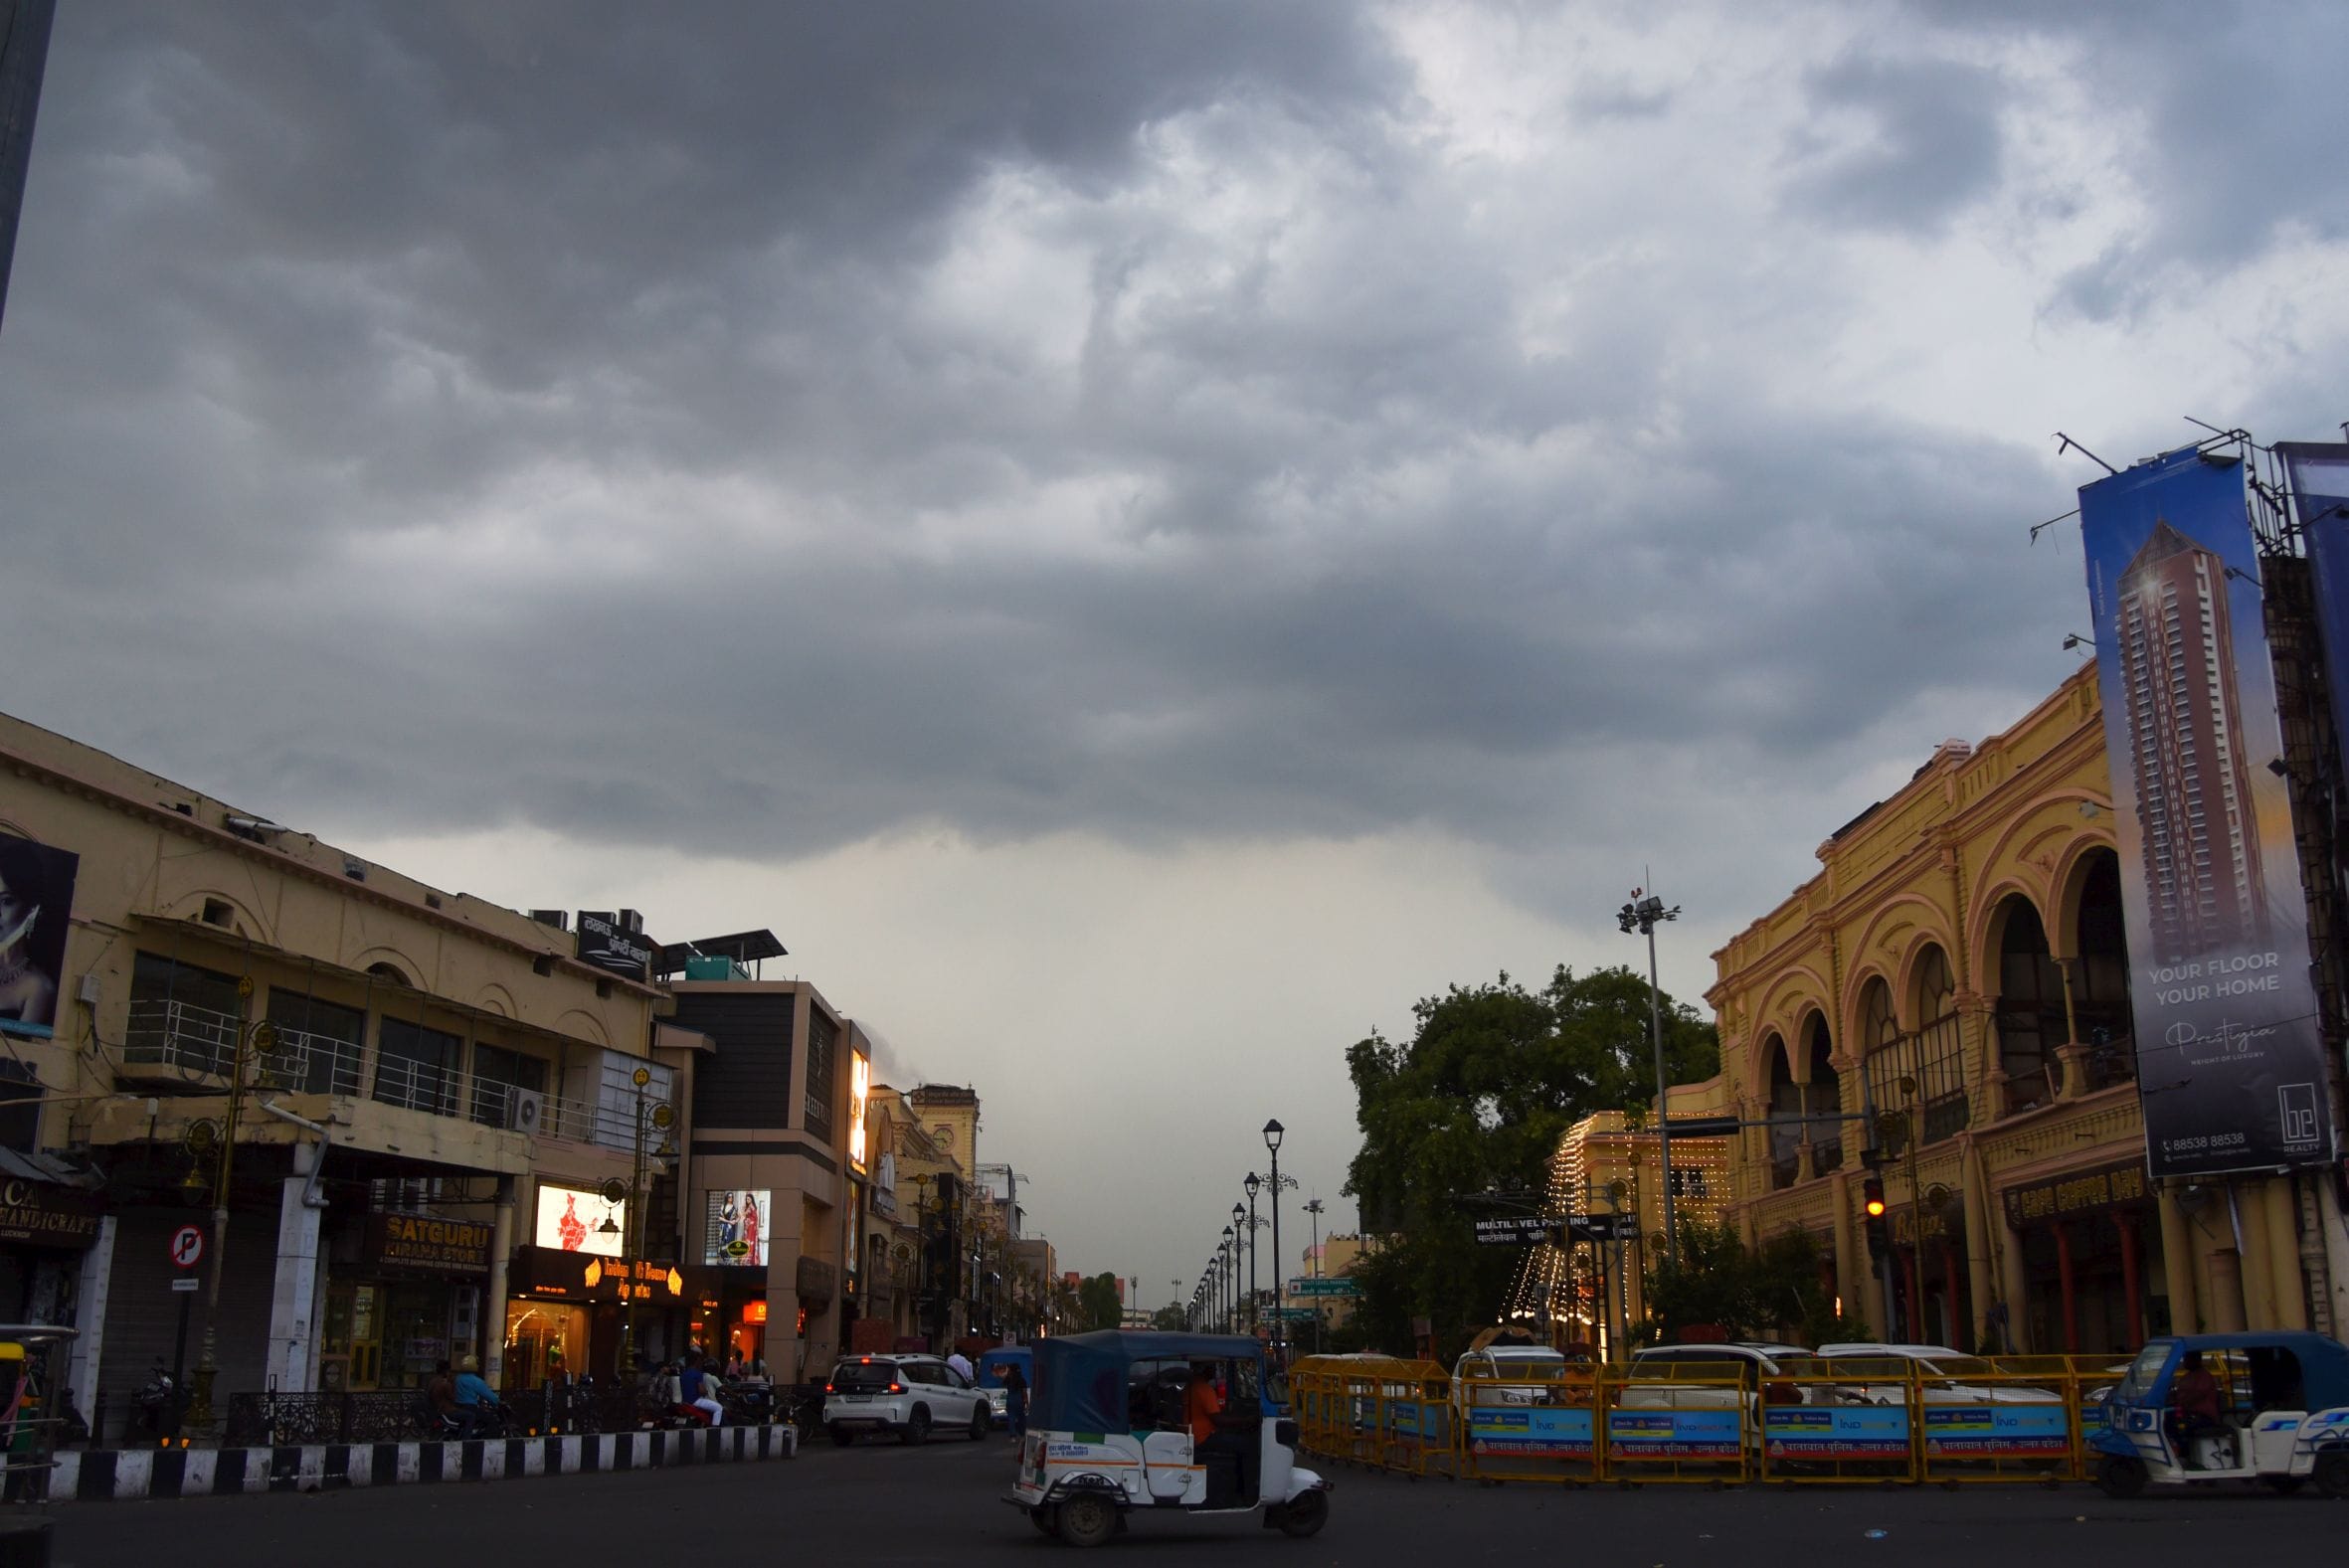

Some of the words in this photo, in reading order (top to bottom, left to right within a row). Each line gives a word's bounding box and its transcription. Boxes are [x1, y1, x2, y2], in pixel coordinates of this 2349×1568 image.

[2148, 962, 2203, 985] YOUR
[2207, 952, 2279, 976] FLOOR
[2156, 984, 2211, 1006] YOUR
[2216, 974, 2280, 997] HOME
[2191, 1056, 2220, 1066] HEIGHT
[2233, 1051, 2266, 1061] LUXURY
[2173, 1135, 2208, 1151] 88538
[2210, 1132, 2246, 1147] 88538
[2283, 1143, 2320, 1153] REALTY
[1541, 1216, 1589, 1227] PARING
[386, 1216, 489, 1249] SATGURU
[604, 1257, 630, 1278] Indian
